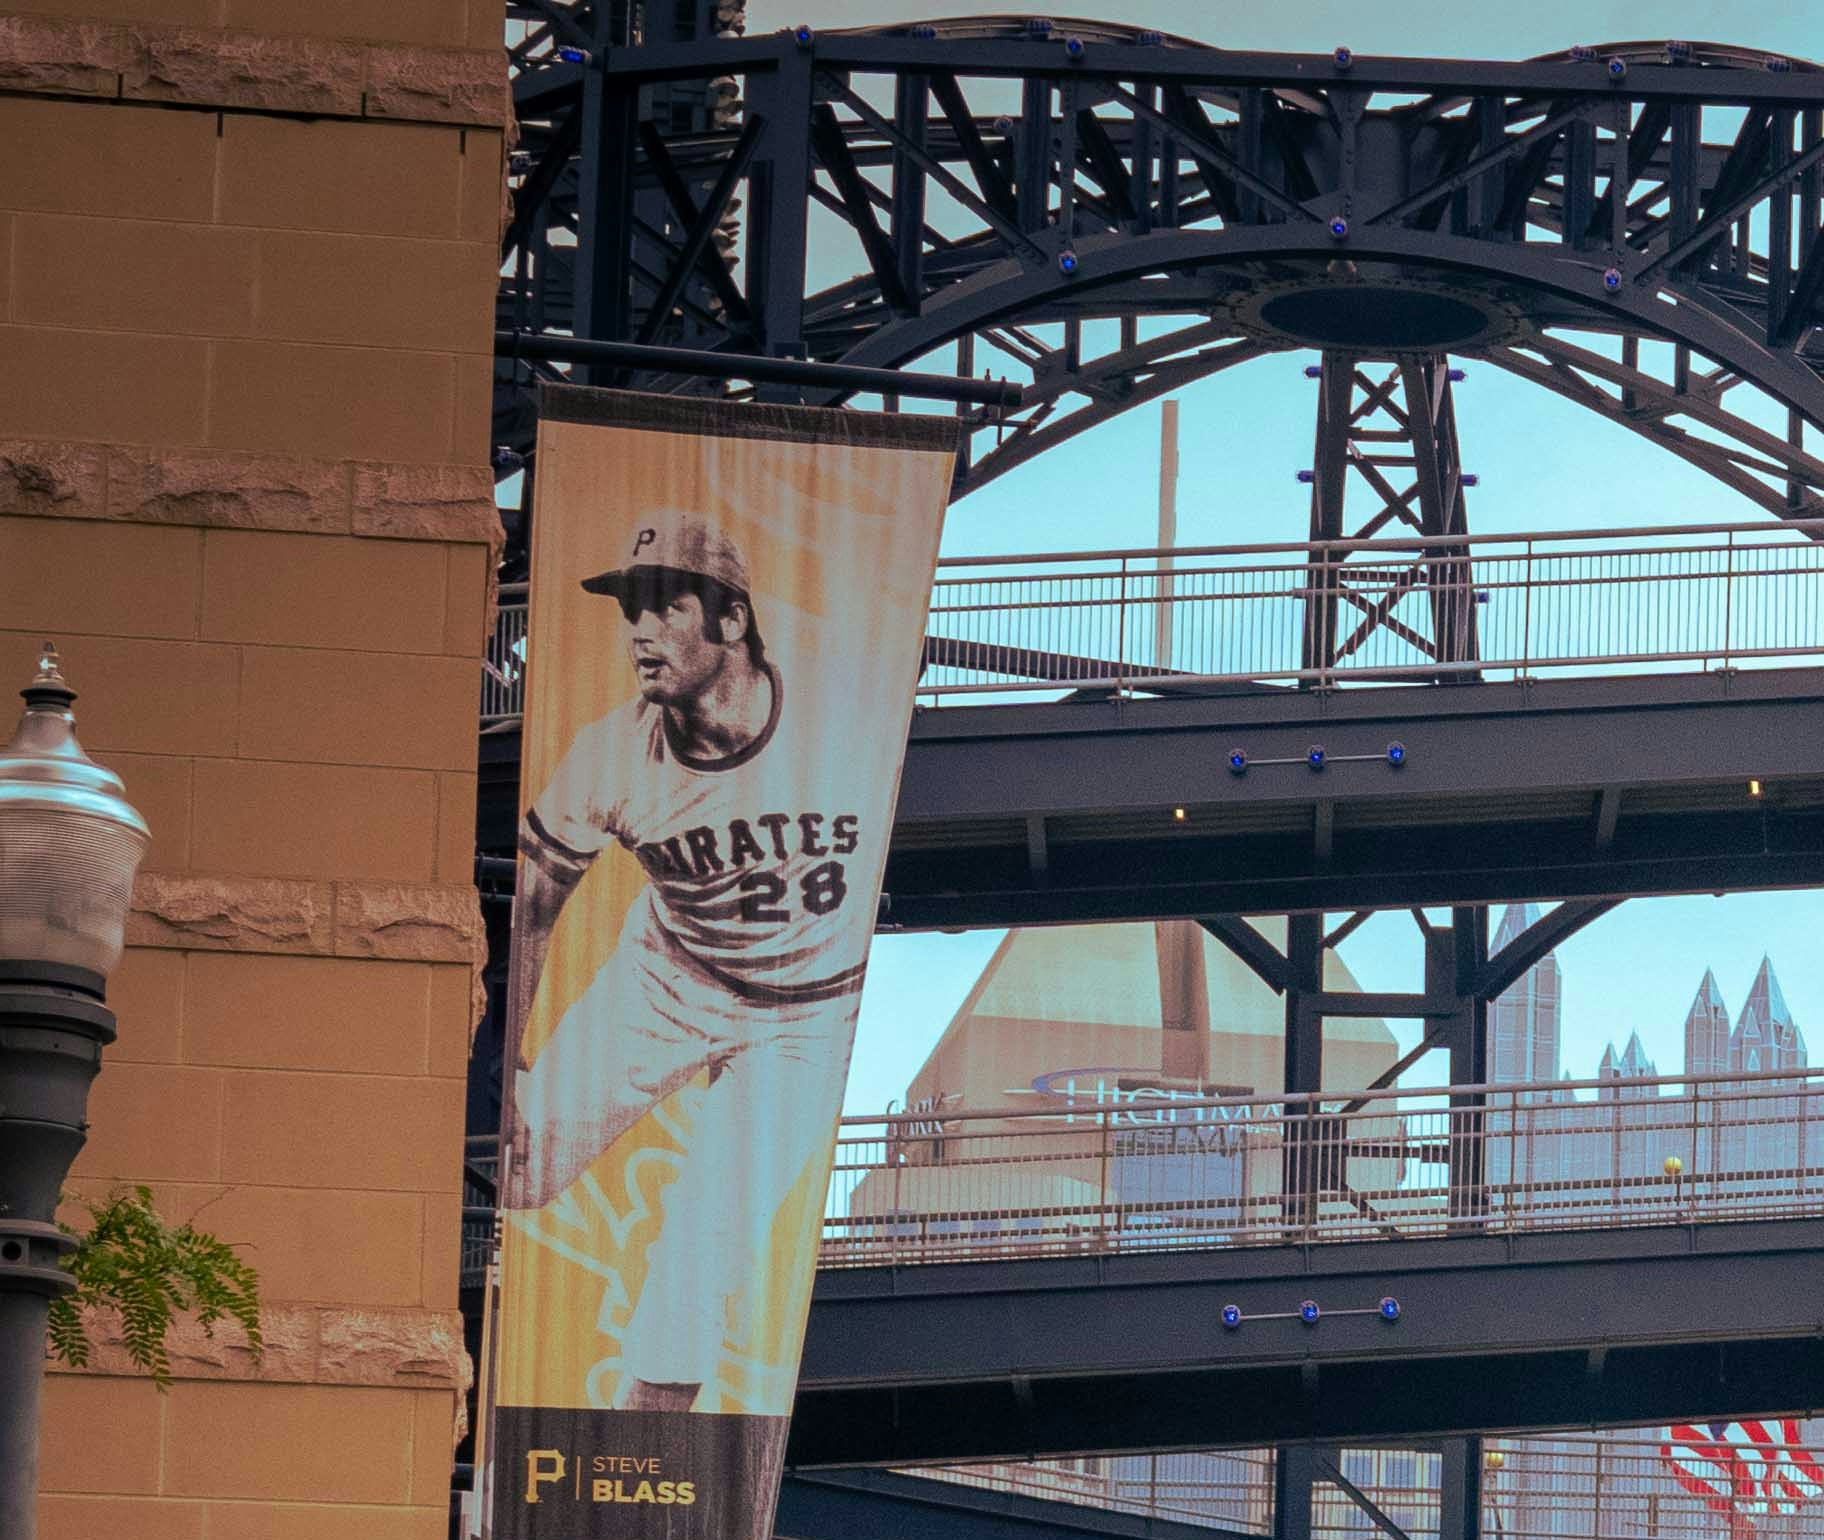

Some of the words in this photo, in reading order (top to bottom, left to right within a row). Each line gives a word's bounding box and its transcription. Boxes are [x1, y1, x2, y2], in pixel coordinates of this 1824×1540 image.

[633, 528, 657, 557] P
[739, 860, 848, 923] 28
[525, 1449, 566, 1503] P
[592, 1456, 662, 1473] STEVE
[592, 1479, 696, 1504] BLASS
